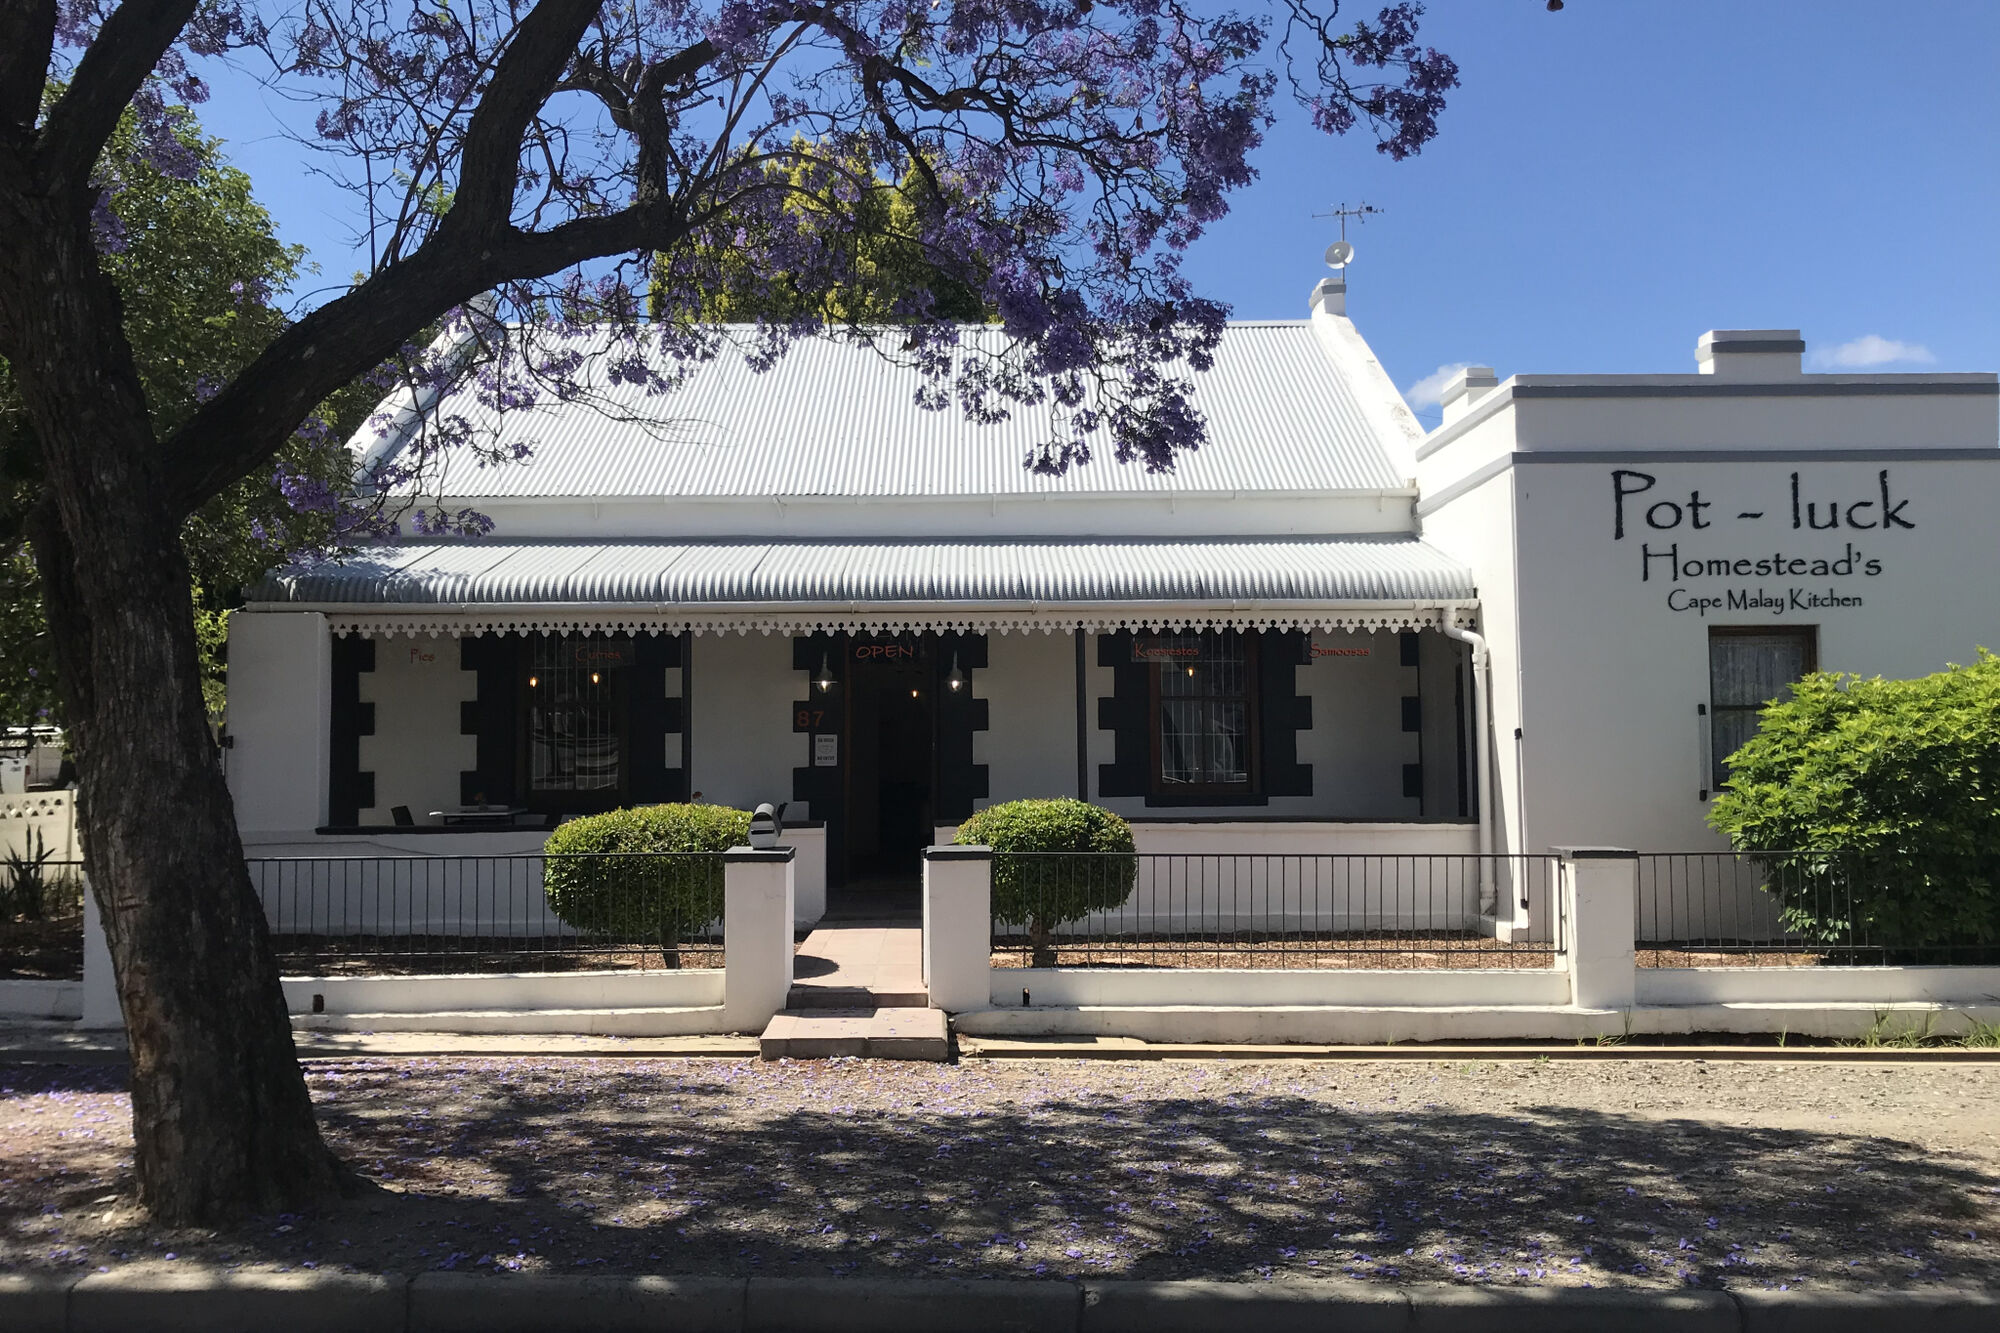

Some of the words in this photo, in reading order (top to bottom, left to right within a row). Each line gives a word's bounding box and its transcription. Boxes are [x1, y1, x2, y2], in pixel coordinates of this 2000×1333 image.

[1611, 470, 1711, 540] Pot
[1791, 469, 1915, 529] luck
[1642, 543, 1882, 581] Homestead's
[1668, 589, 1722, 616] Cape
[1727, 589, 1785, 615] Malay
[1790, 588, 1863, 610] Kitchen
[410, 648, 435, 663] Pies
[855, 645, 913, 659] OPEN
[1308, 643, 1370, 659] Samoosas
[797, 710, 824, 728] 87
